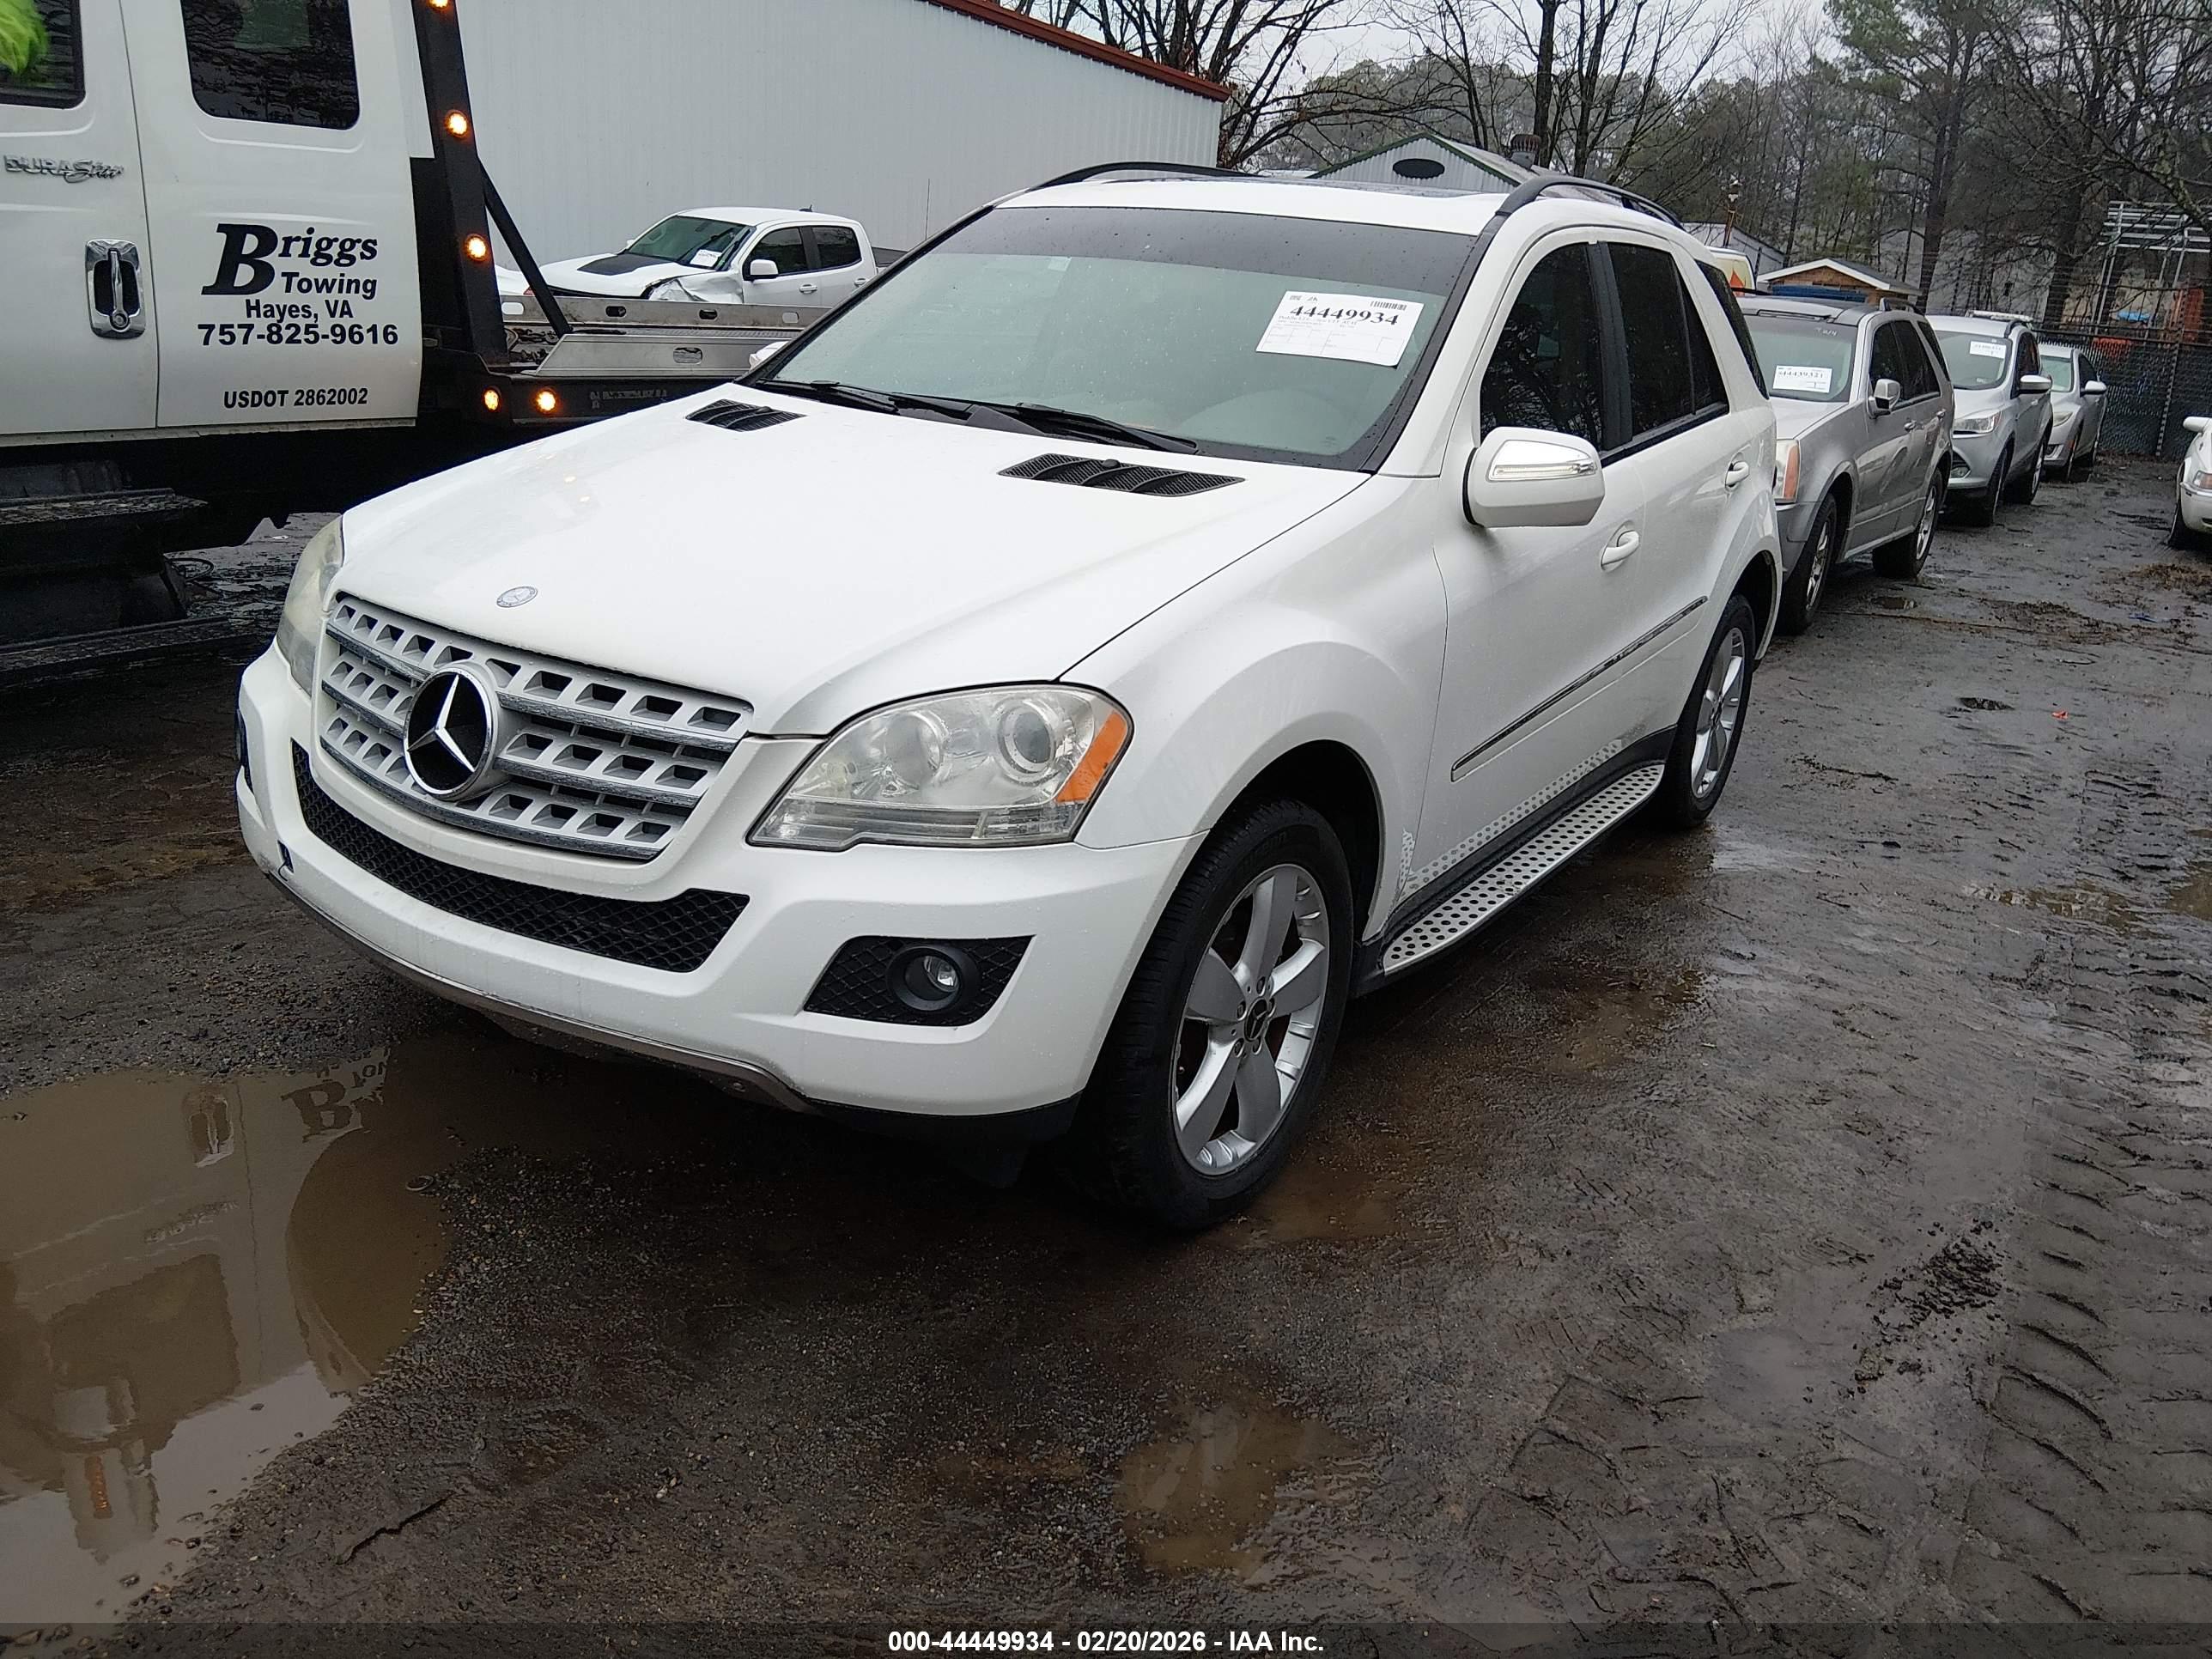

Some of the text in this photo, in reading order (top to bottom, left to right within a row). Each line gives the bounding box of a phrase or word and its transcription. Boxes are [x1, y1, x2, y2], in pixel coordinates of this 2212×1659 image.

[201, 223, 378, 295] Briggs
[281, 271, 377, 300] Towing
[246, 299, 354, 323] Hayes, VA
[1290, 306, 1399, 325] 44449934
[198, 323, 398, 345] 757-825-9616
[223, 387, 368, 409] USDOT 2862002
